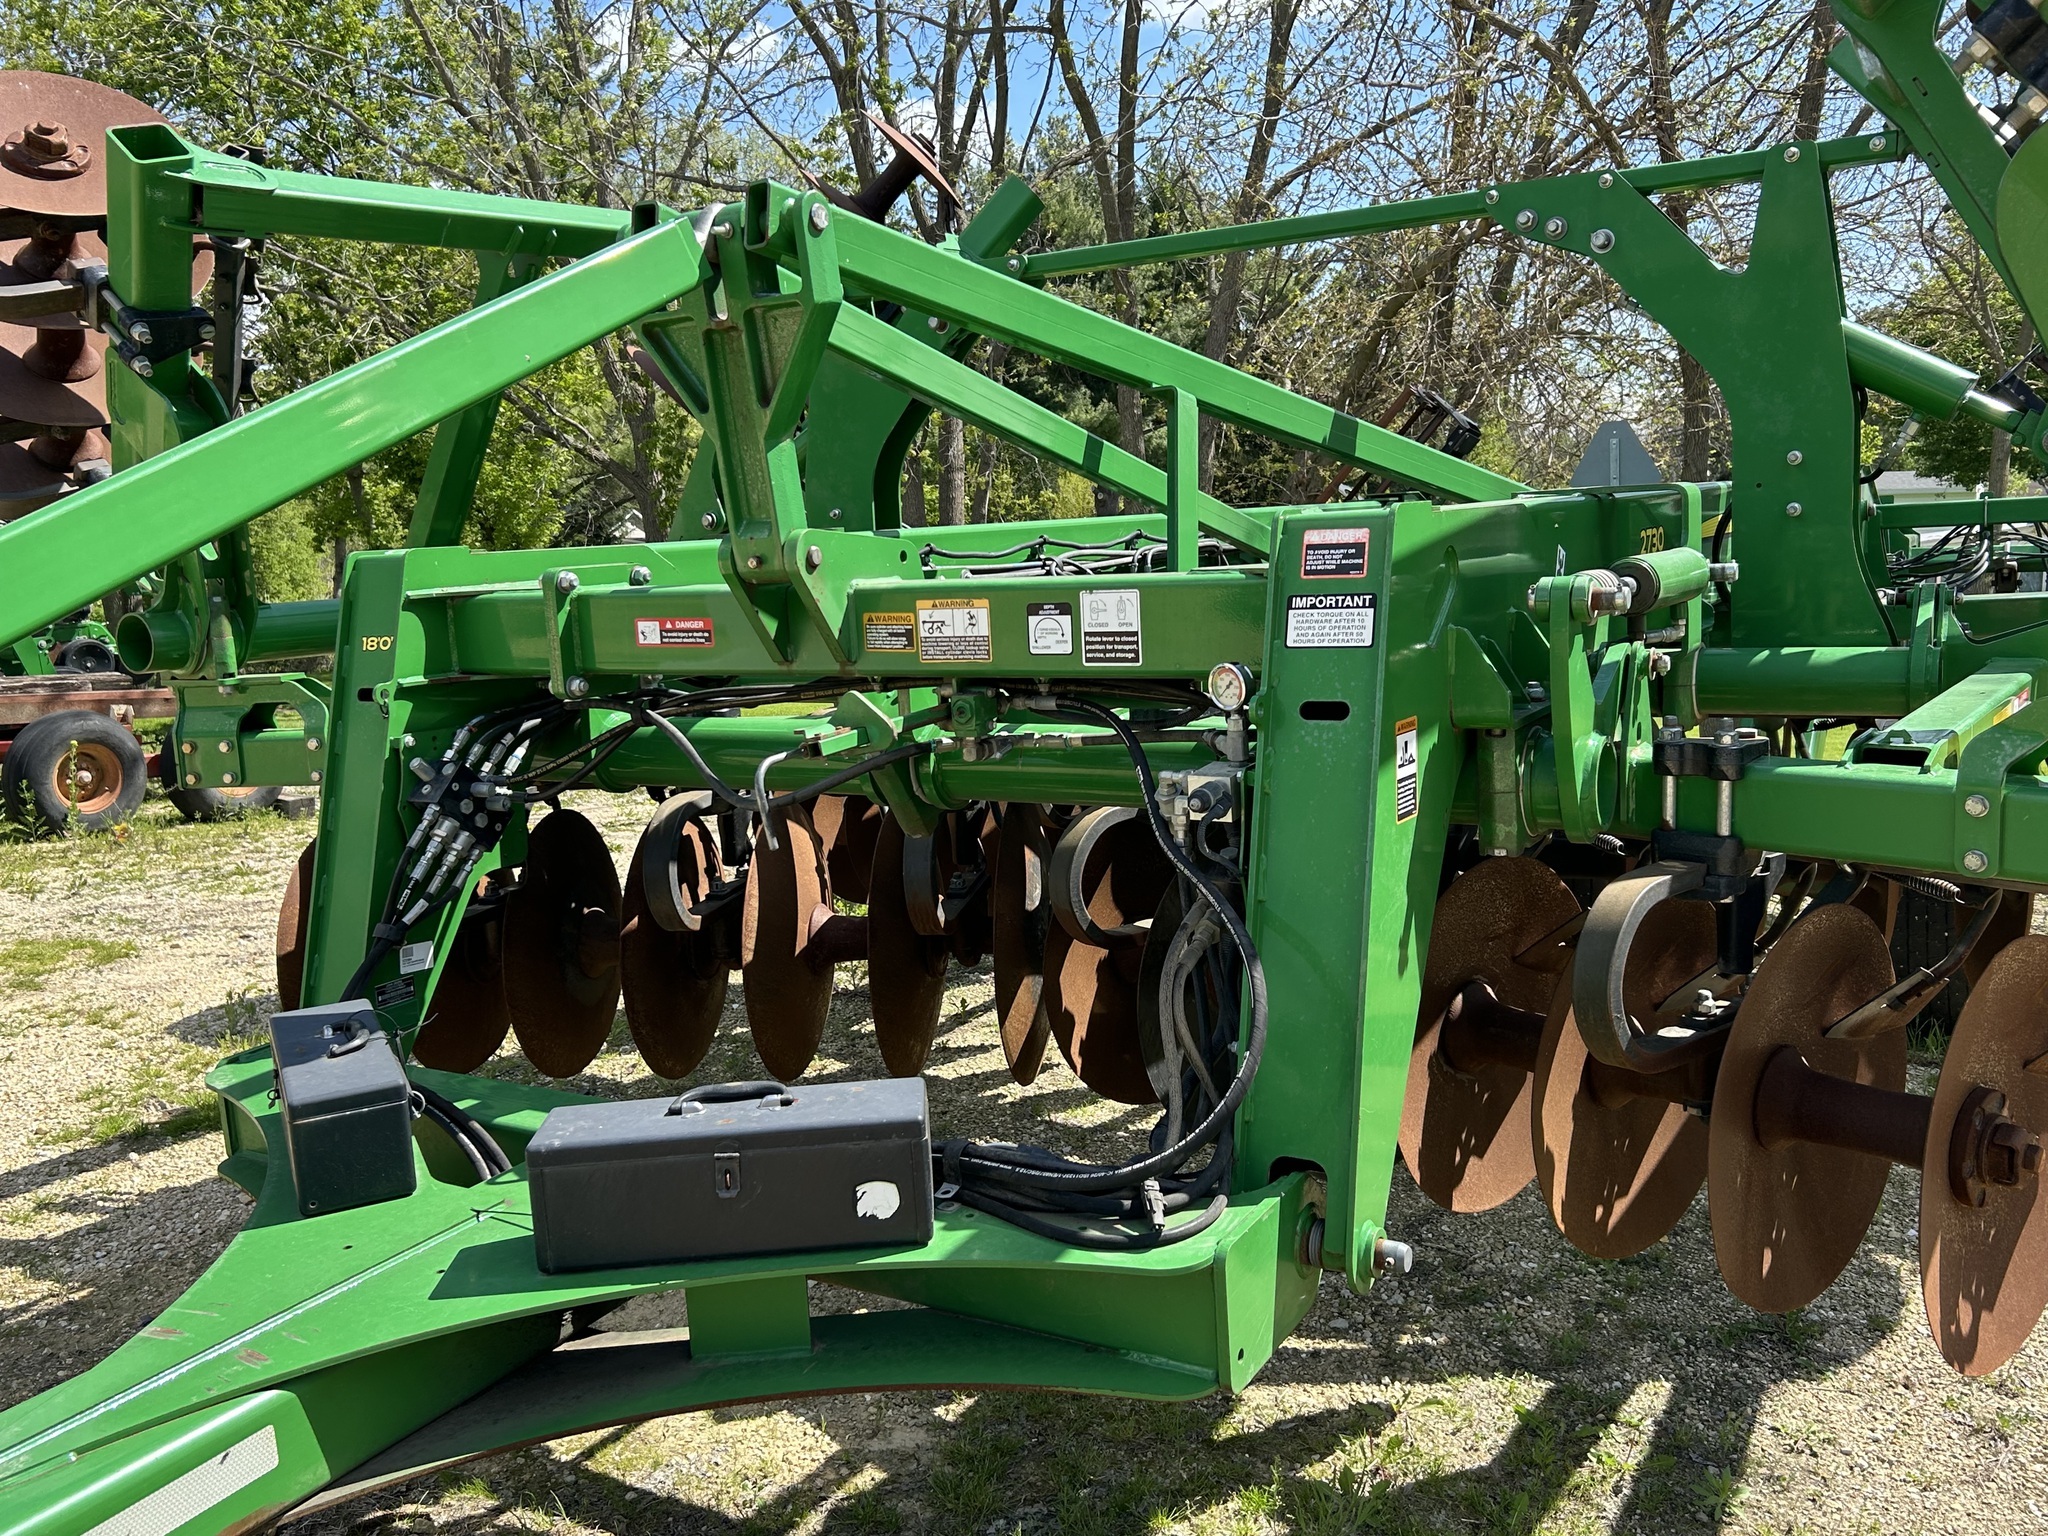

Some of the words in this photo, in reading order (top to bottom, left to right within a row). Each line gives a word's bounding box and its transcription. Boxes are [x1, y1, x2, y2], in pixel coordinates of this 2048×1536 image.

[1321, 532, 1362, 541] DANGER
[1640, 526, 1664, 554] 2730
[938, 600, 975, 608] WARNING
[1292, 595, 1372, 608] IMPORTANT
